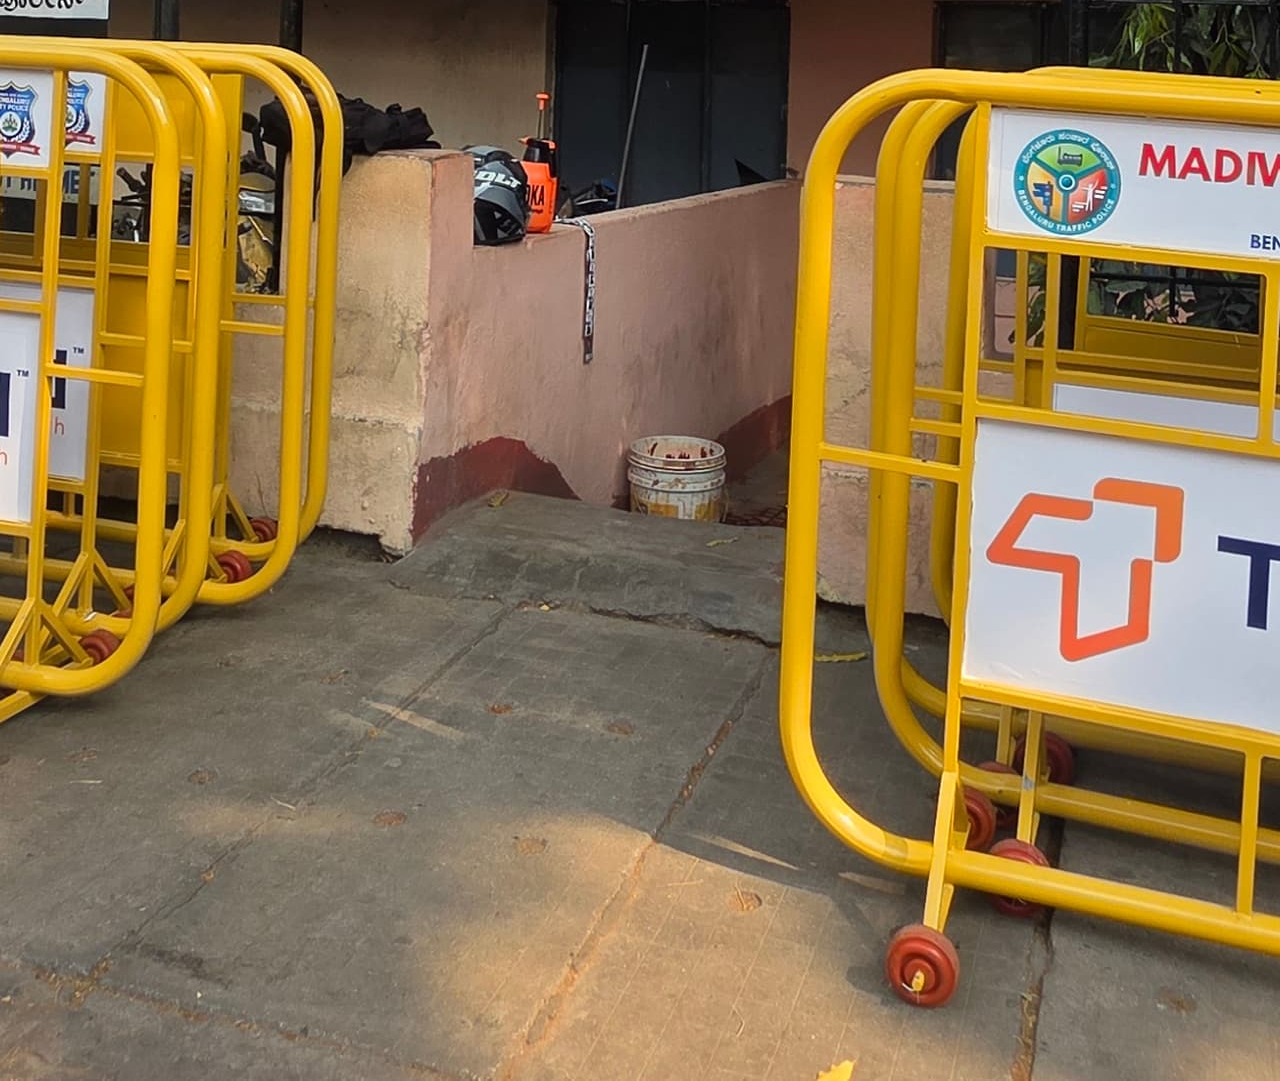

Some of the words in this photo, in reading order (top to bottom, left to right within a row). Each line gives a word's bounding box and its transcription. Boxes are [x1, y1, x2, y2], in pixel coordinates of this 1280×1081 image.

[474, 170, 522, 189] OLT
[1018, 189, 1055, 229] BENGALURU
[1056, 221, 1092, 233] TRAFFIC
[1092, 198, 1115, 225] POLICE
